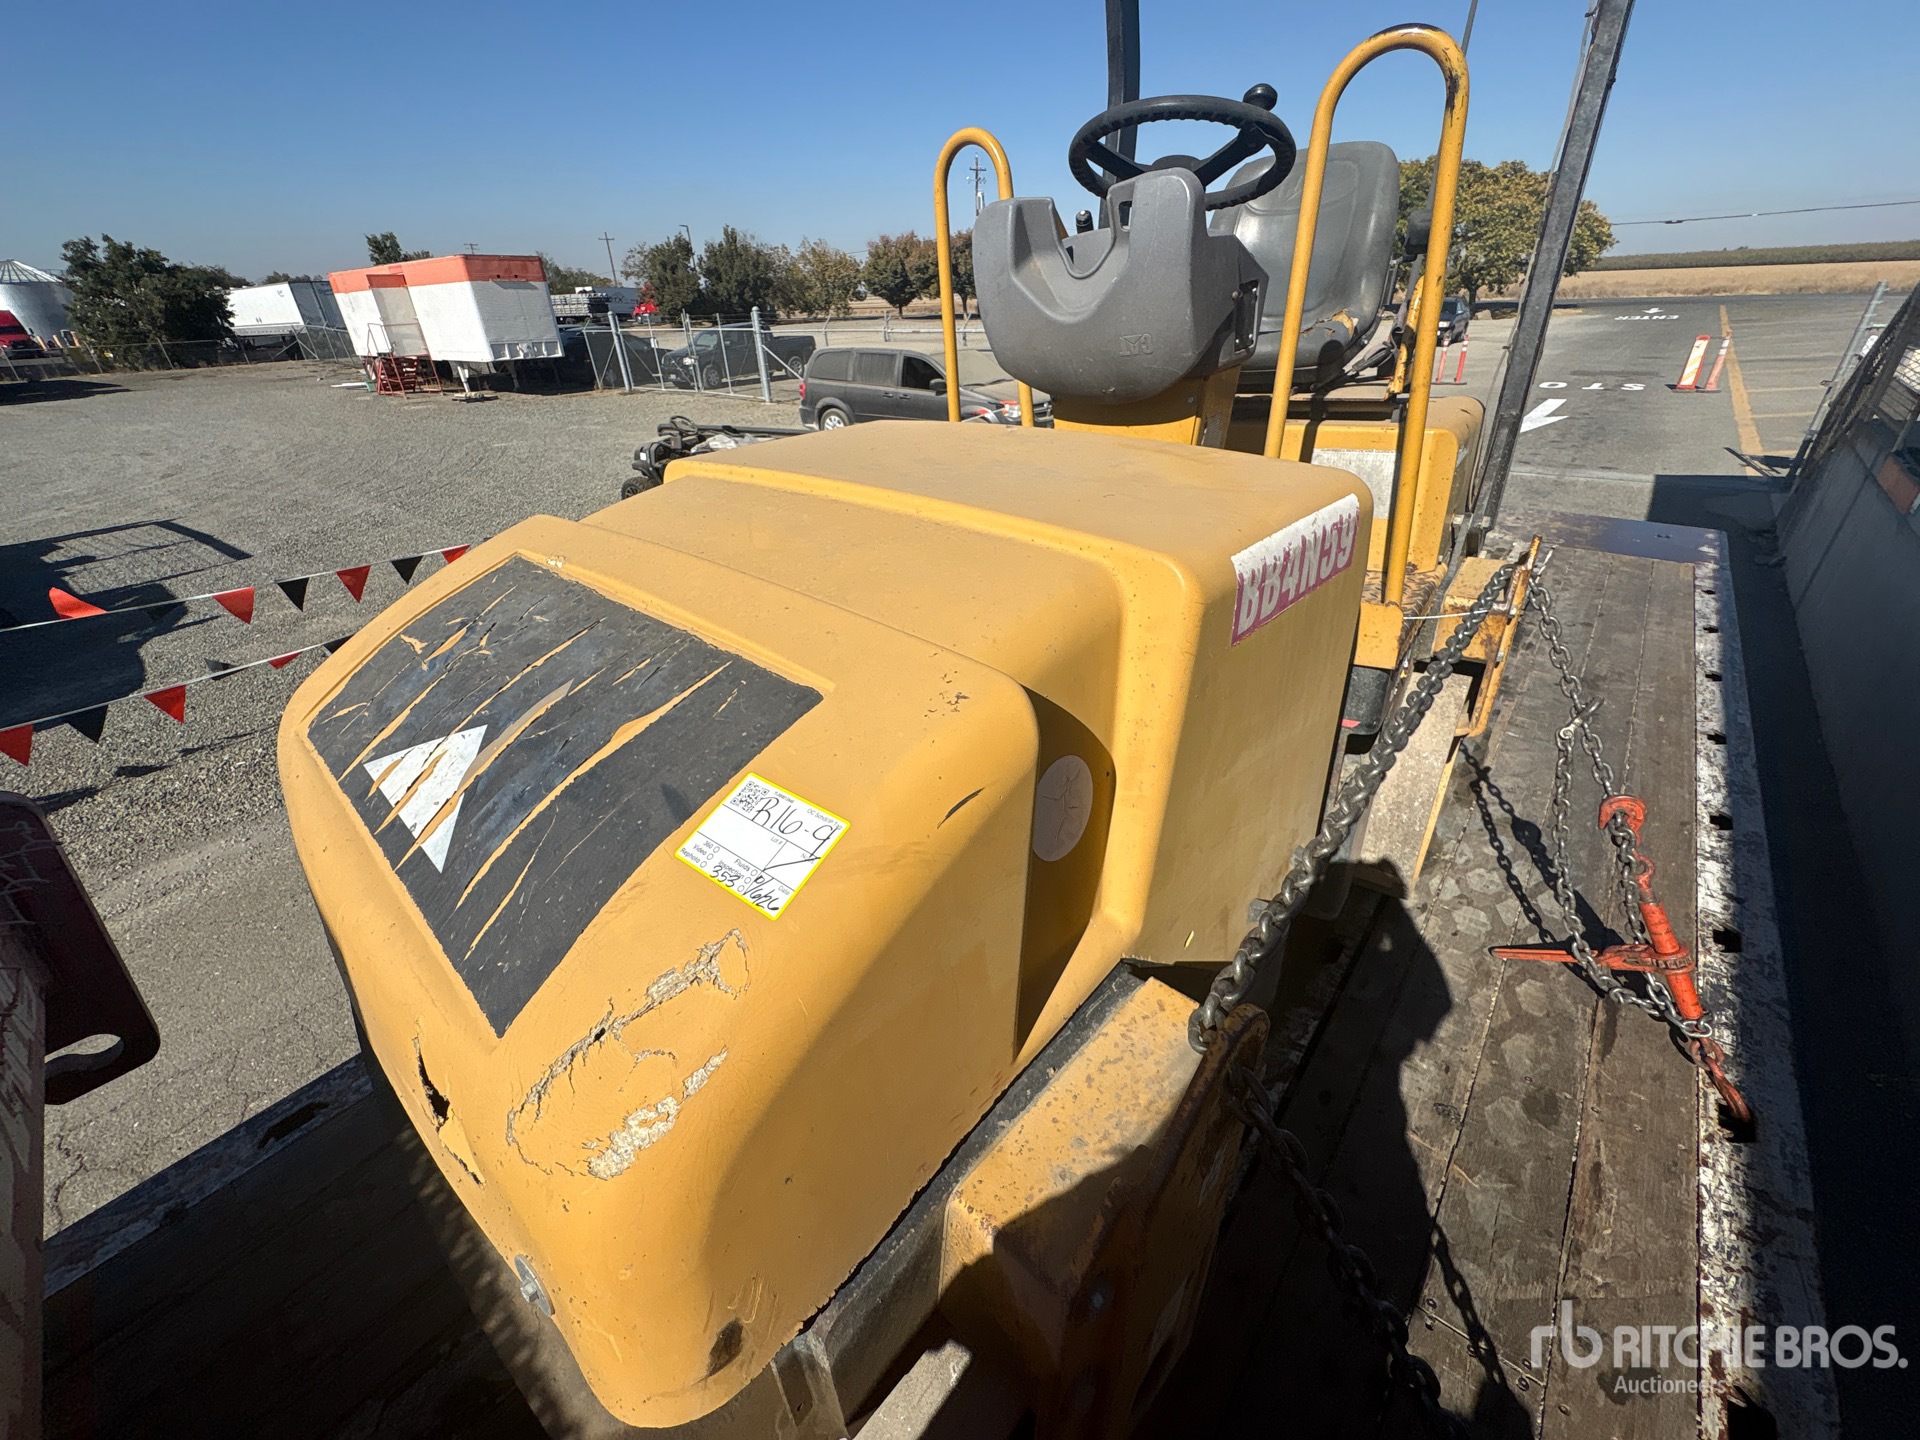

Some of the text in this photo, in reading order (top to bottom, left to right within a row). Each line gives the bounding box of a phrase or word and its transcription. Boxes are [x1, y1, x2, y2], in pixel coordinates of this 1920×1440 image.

[1538, 381, 1647, 391] STO
[693, 843, 707, 856] Video
[703, 840, 714, 849] 360
[680, 847, 701, 863] Rephoto
[718, 860, 745, 879] Inspection
[734, 858, 751, 872] Fluids
[709, 865, 741, 888] 353
[778, 885, 790, 896] Date
